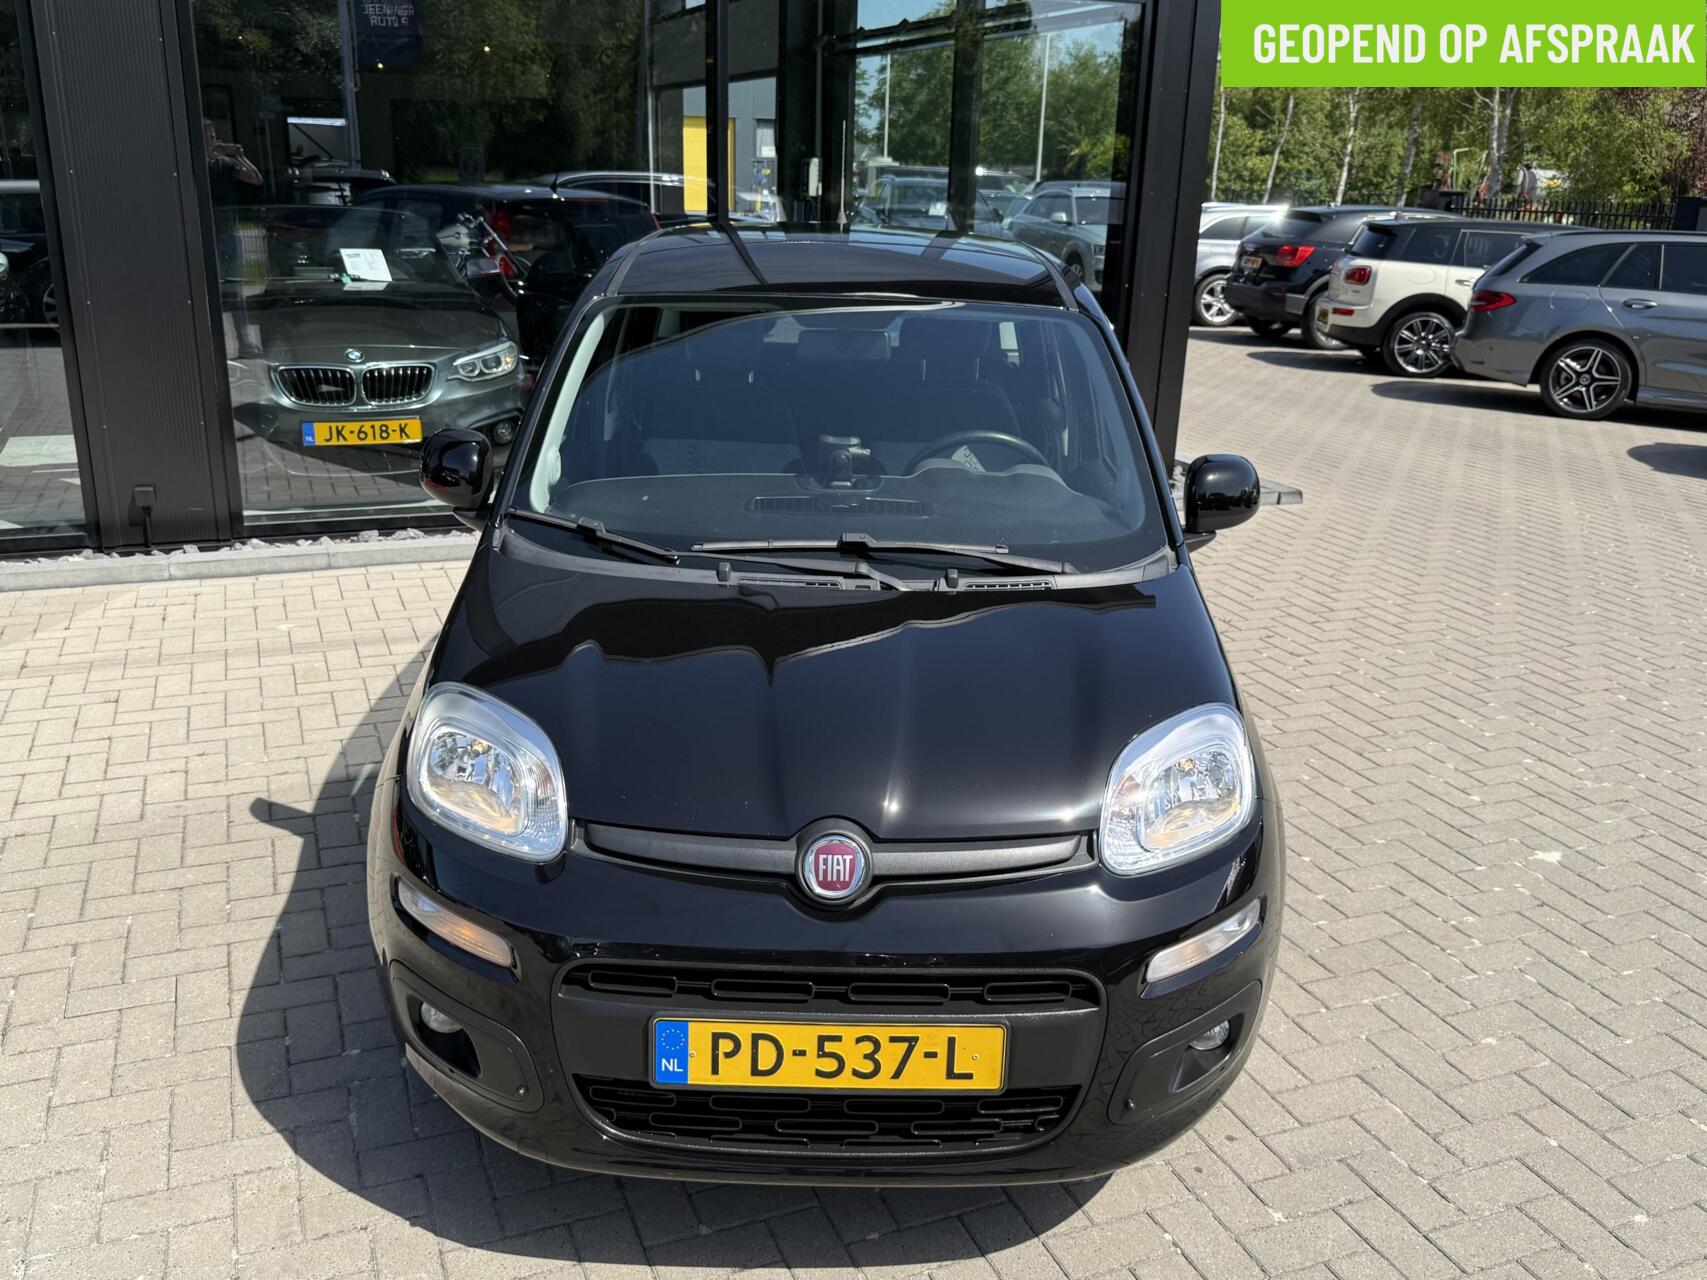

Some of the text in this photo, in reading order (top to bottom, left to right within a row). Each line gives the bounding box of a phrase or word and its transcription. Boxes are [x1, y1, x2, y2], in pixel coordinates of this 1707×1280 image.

[324, 423, 410, 442] JK-618-K
[818, 854, 853, 882] FIAT
[661, 1057, 684, 1072] NL
[710, 1031, 974, 1080] PD-537-L
